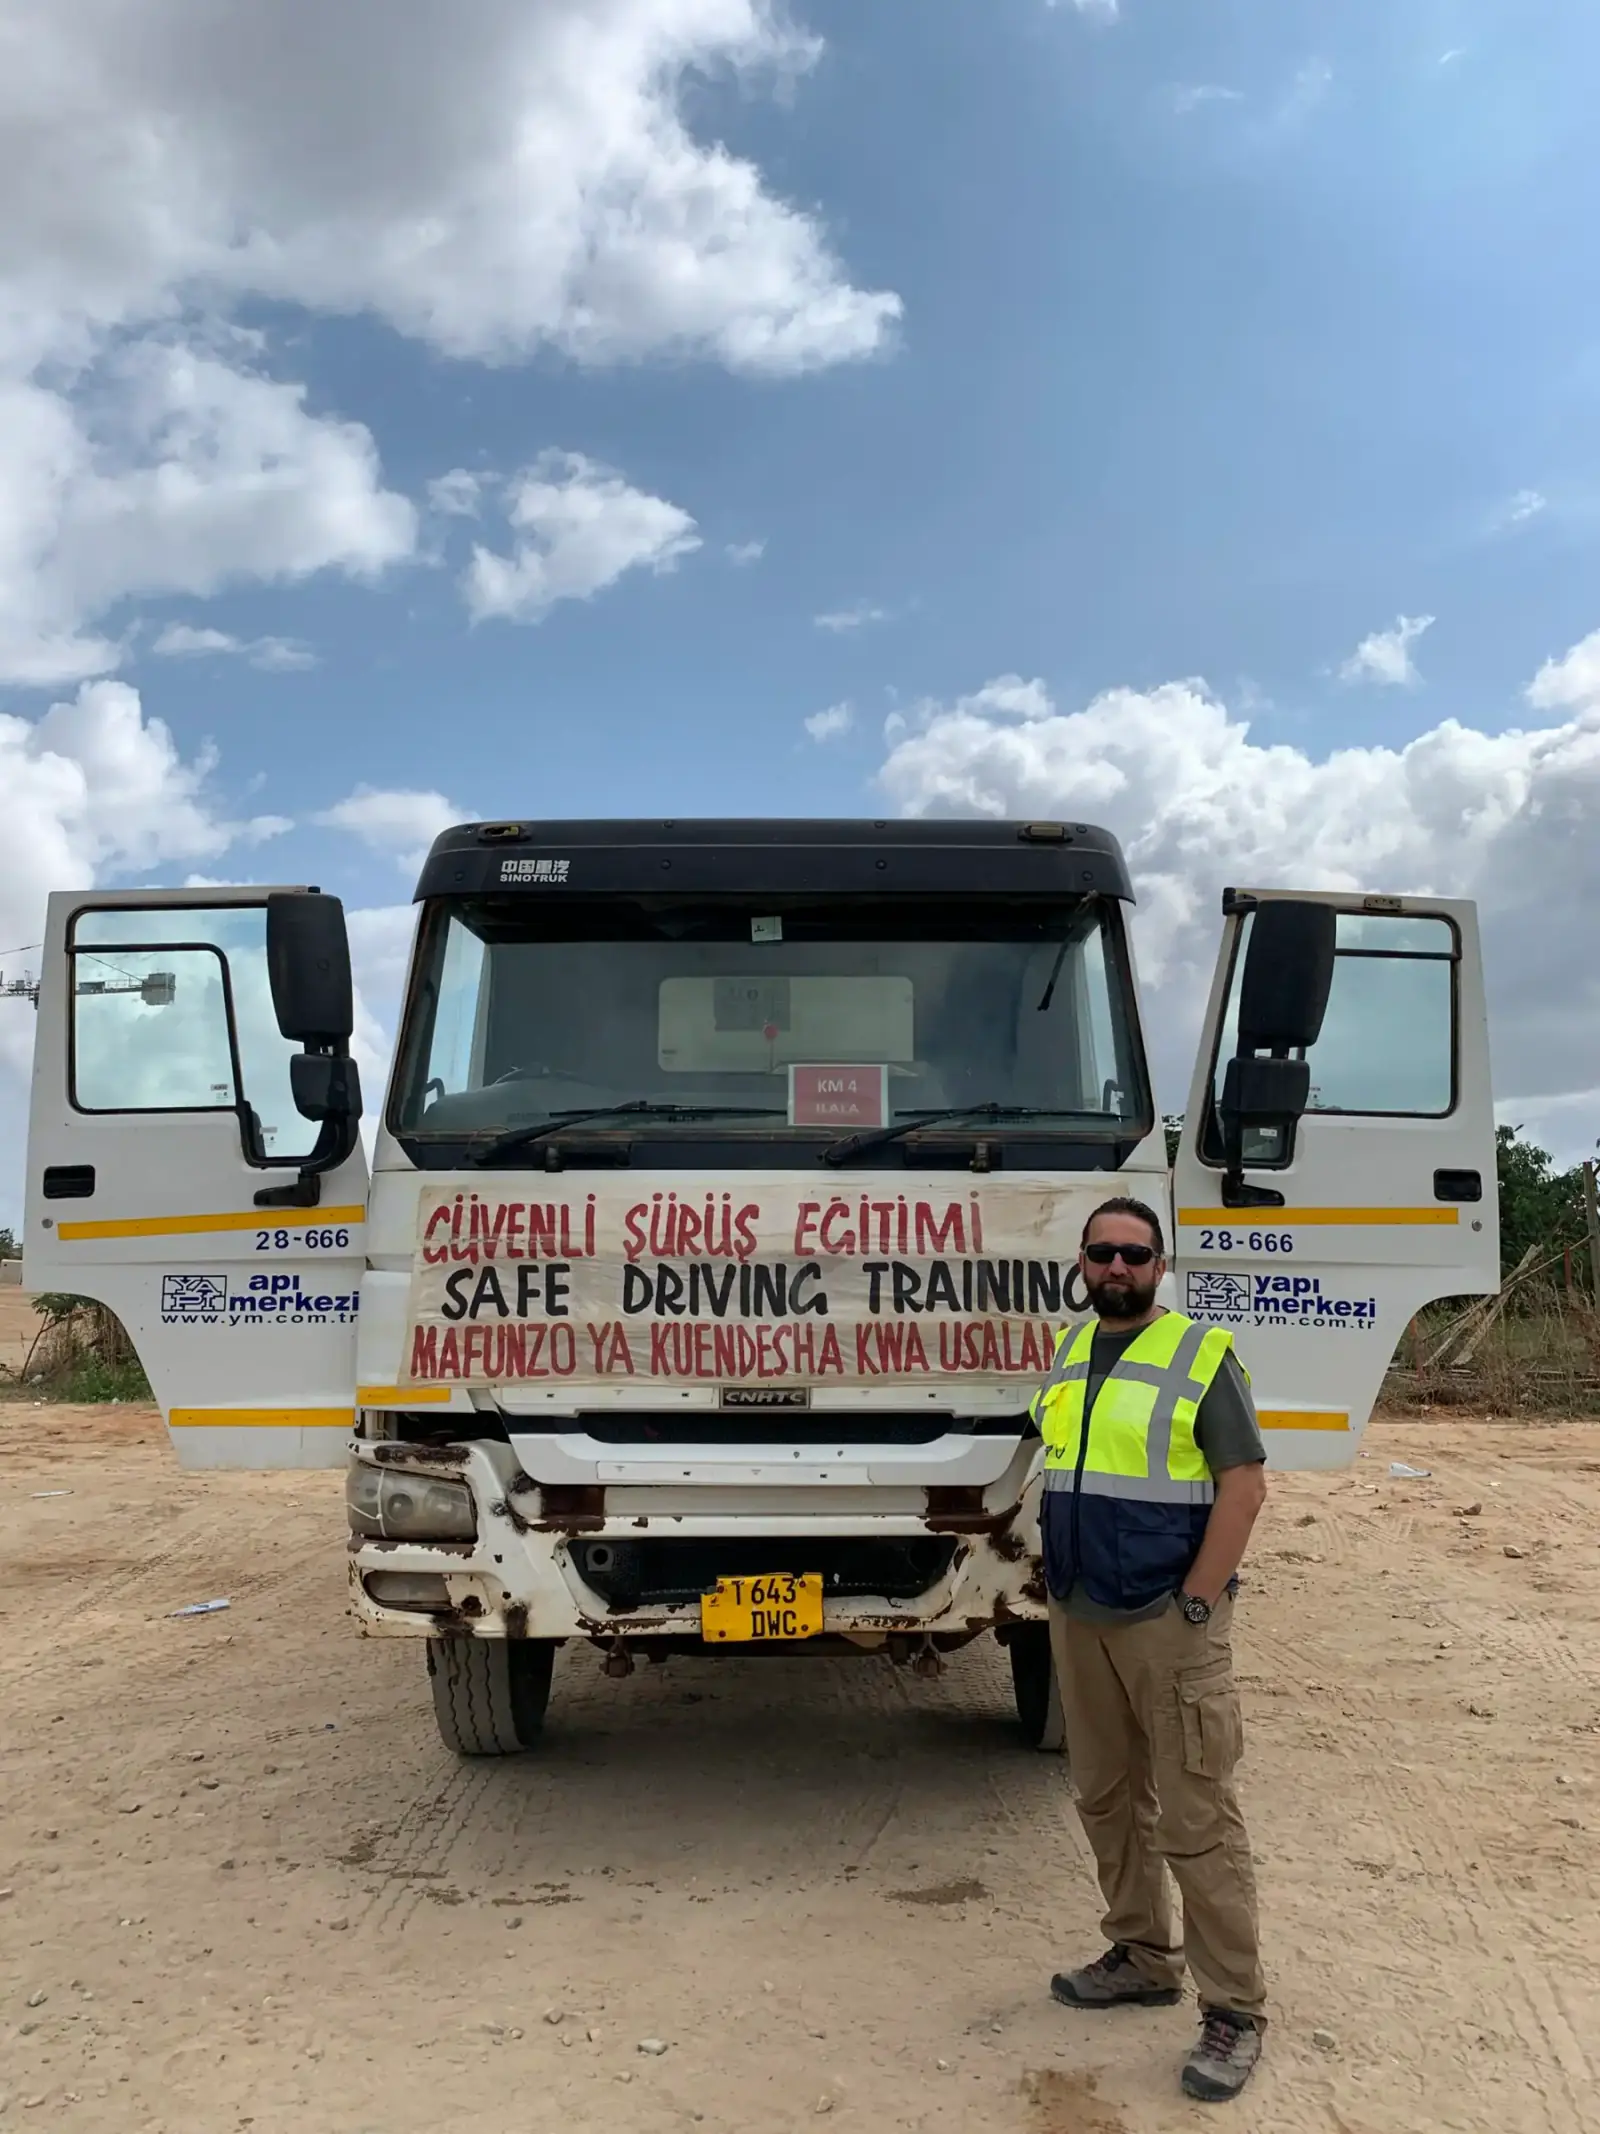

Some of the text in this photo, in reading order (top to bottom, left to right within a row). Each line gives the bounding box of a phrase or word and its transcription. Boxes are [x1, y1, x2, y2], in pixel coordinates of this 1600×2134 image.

[500, 874, 568, 882] SINOTRUK
[817, 1080, 857, 1093] KM 4
[255, 1229, 349, 1250] 28-666
[1200, 1230, 1294, 1253] 28-666
[229, 1291, 360, 1312] merkezi
[441, 1263, 570, 1320] SAFE
[623, 1262, 829, 1317] DRIVING
[1253, 1295, 1376, 1318] merkezi
[161, 1312, 359, 1327] www.ym.com.tr
[1187, 1311, 1376, 1330] www.ym.com.tr
[410, 1324, 576, 1378] MAFUNZO
[587, 1321, 635, 1375] YA
[651, 1321, 844, 1377] KUENDESHA
[856, 1321, 930, 1375] KWA
[726, 1390, 804, 1403] CNHTC
[732, 1578, 796, 1605] T 643
[751, 1610, 797, 1637] DWC
